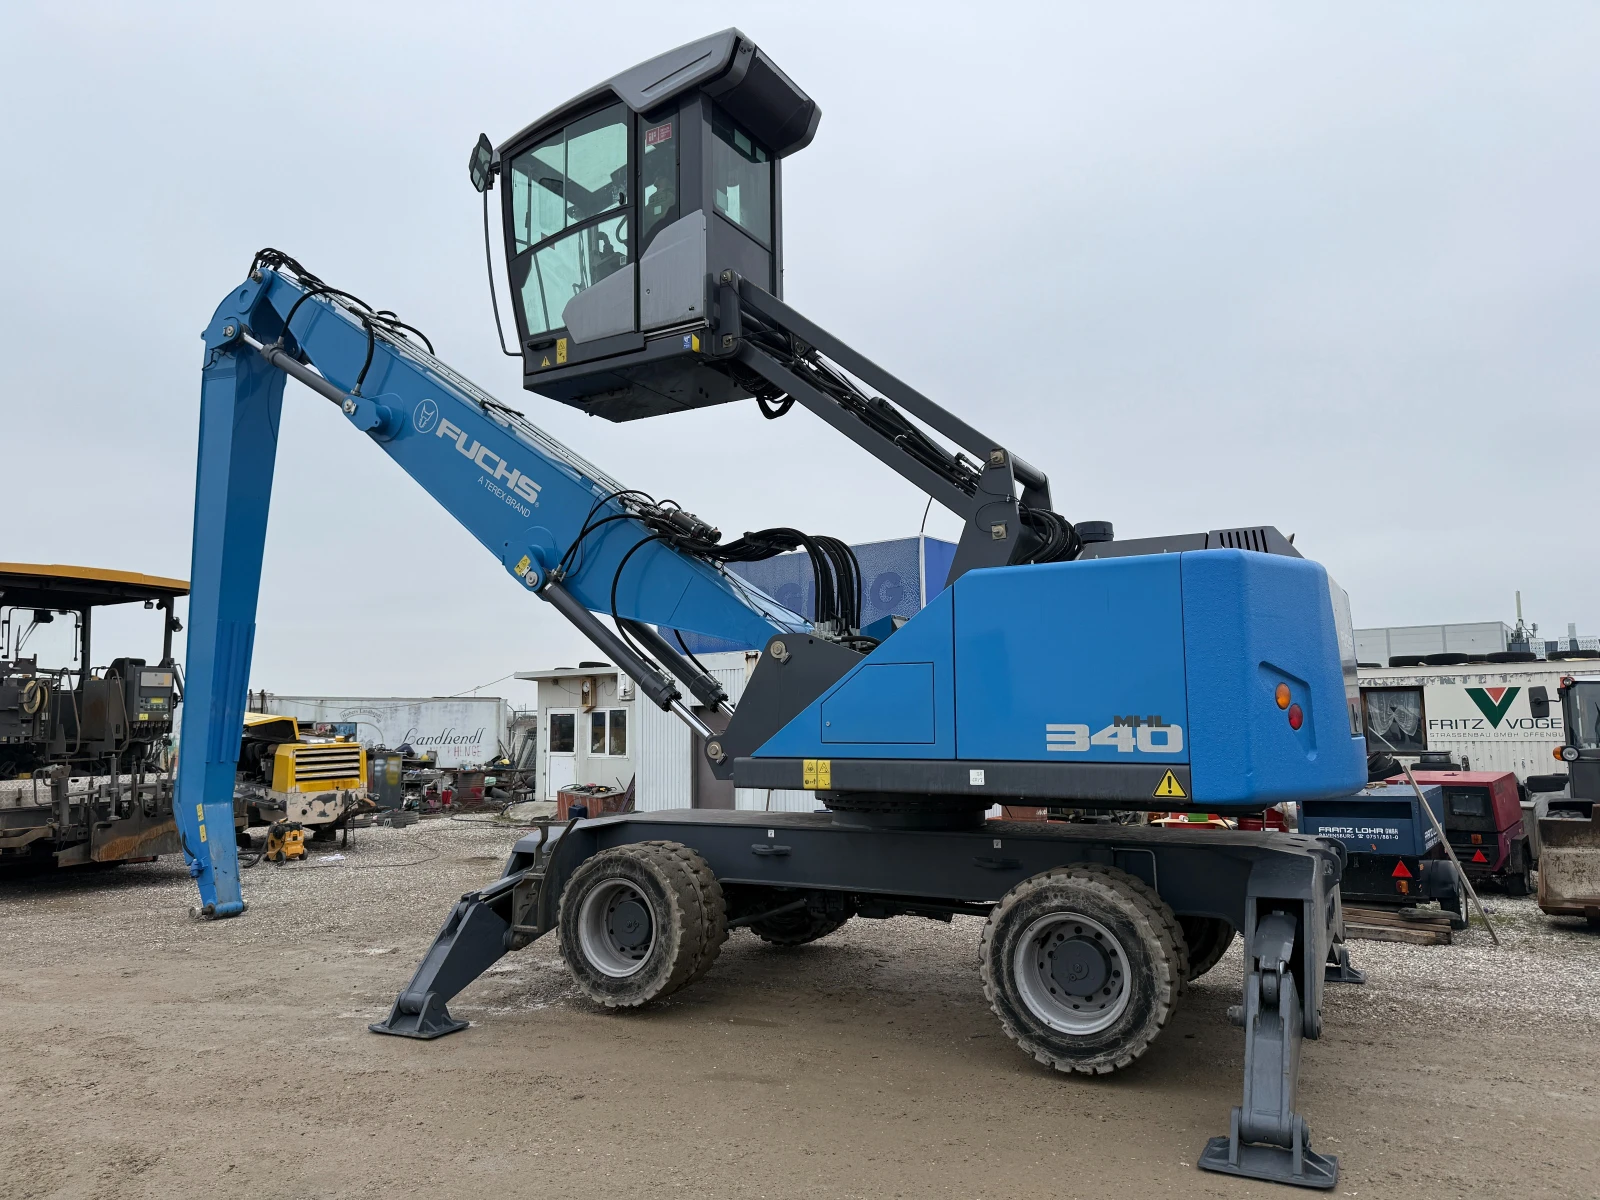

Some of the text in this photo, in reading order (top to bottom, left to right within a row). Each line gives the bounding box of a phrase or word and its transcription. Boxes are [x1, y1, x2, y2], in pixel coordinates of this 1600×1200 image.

[435, 418, 542, 504] FUCHS
[477, 476, 531, 518] A TEREX BRAND
[1113, 715, 1171, 727] MHL
[1429, 718, 1485, 730] FRITZ
[401, 727, 486, 745] Landhendl
[1046, 723, 1184, 753] 340
